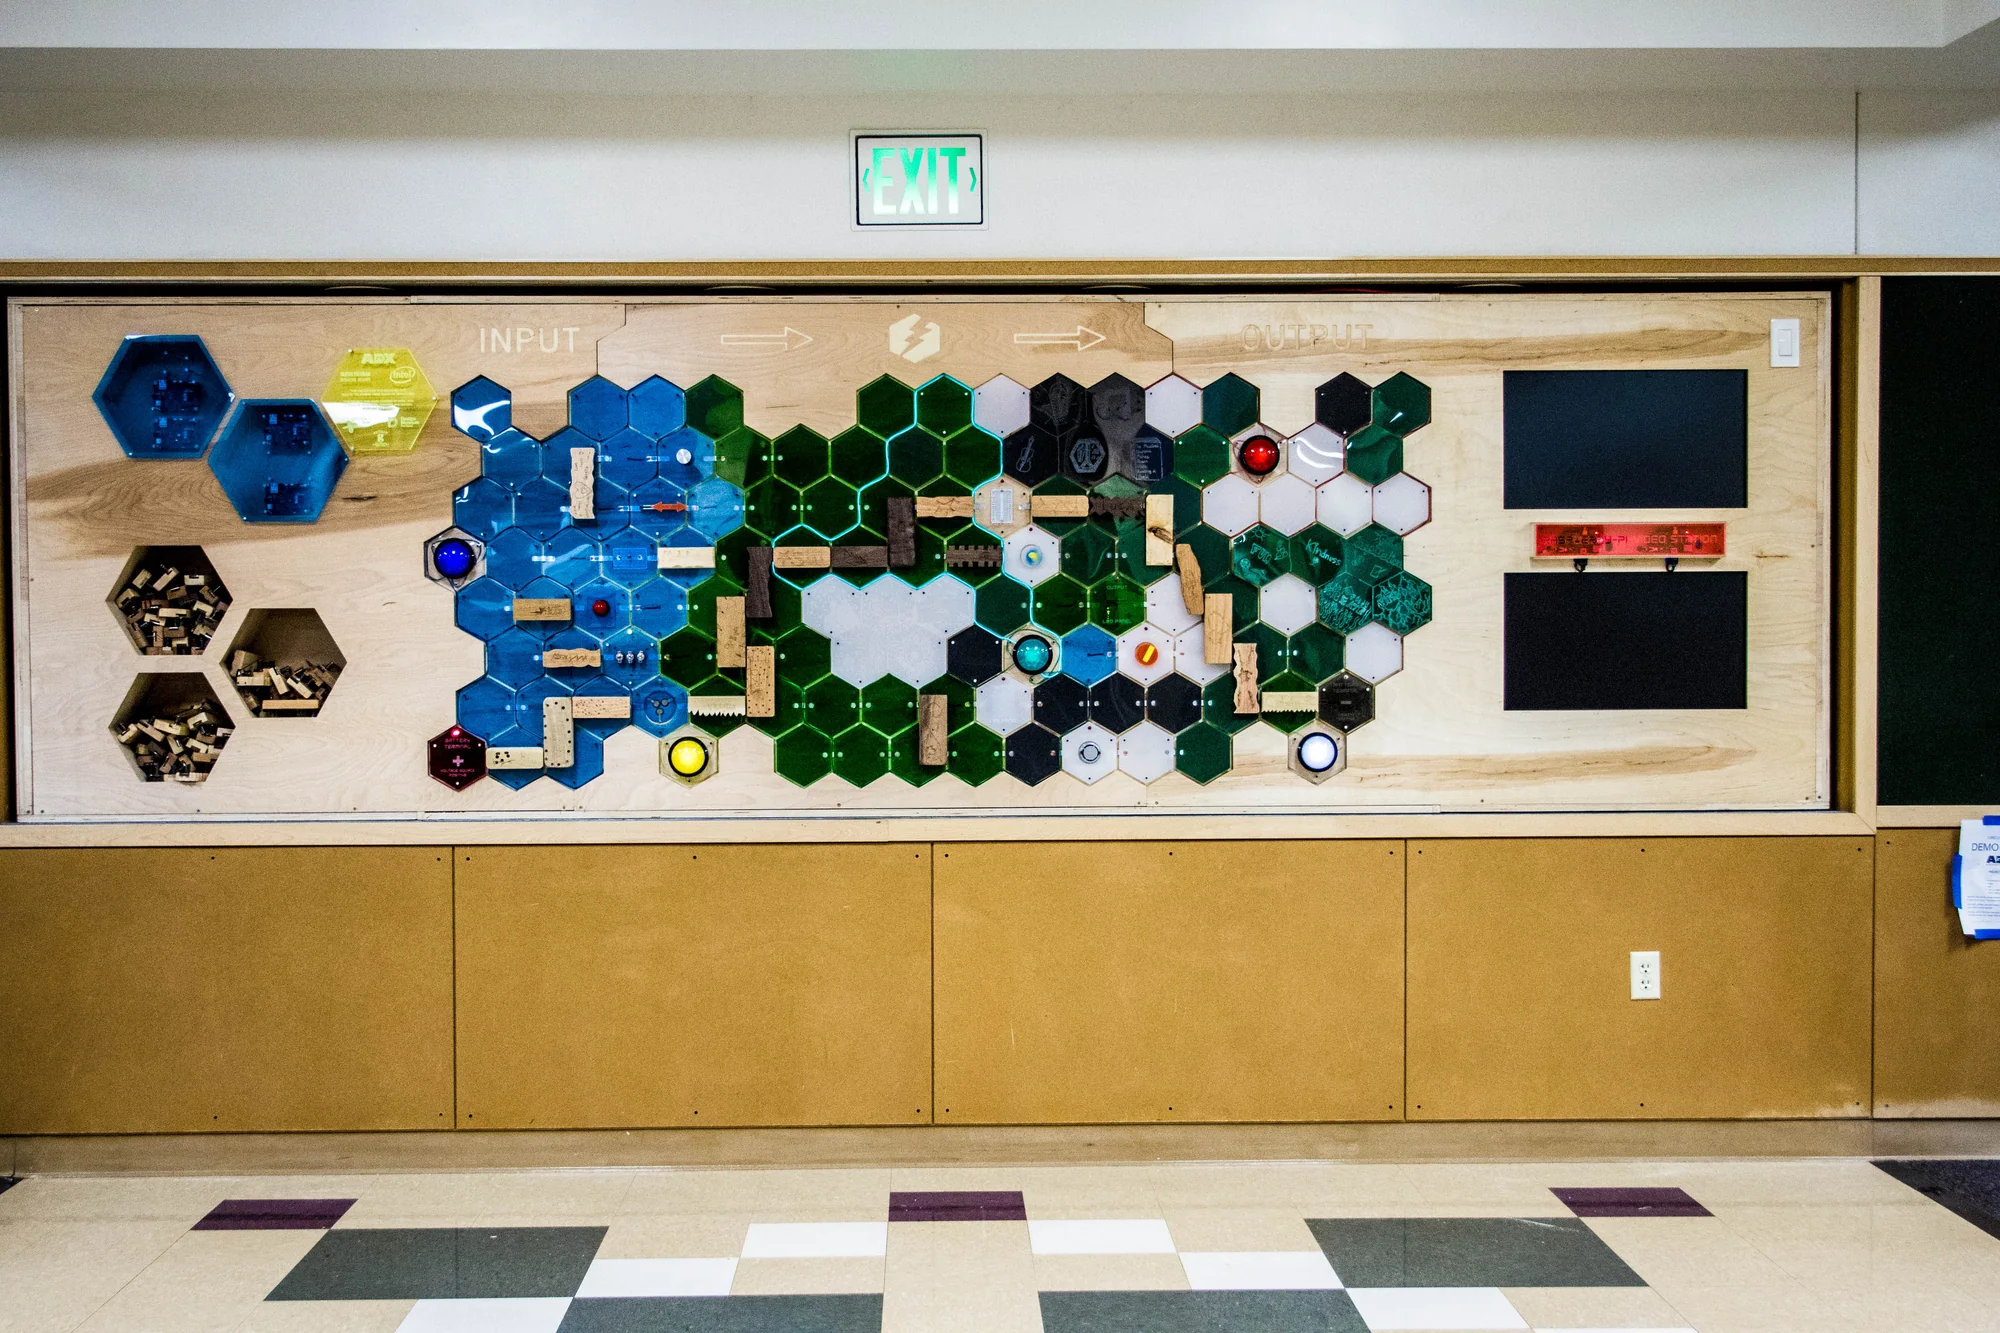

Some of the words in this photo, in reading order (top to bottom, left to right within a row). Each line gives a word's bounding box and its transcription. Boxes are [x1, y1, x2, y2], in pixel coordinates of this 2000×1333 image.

[872, 147, 966, 215] EXIT
[480, 327, 580, 353] INPUT
[1240, 323, 1374, 351] OUTPUT
[1971, 842, 1999, 852] DEMO
